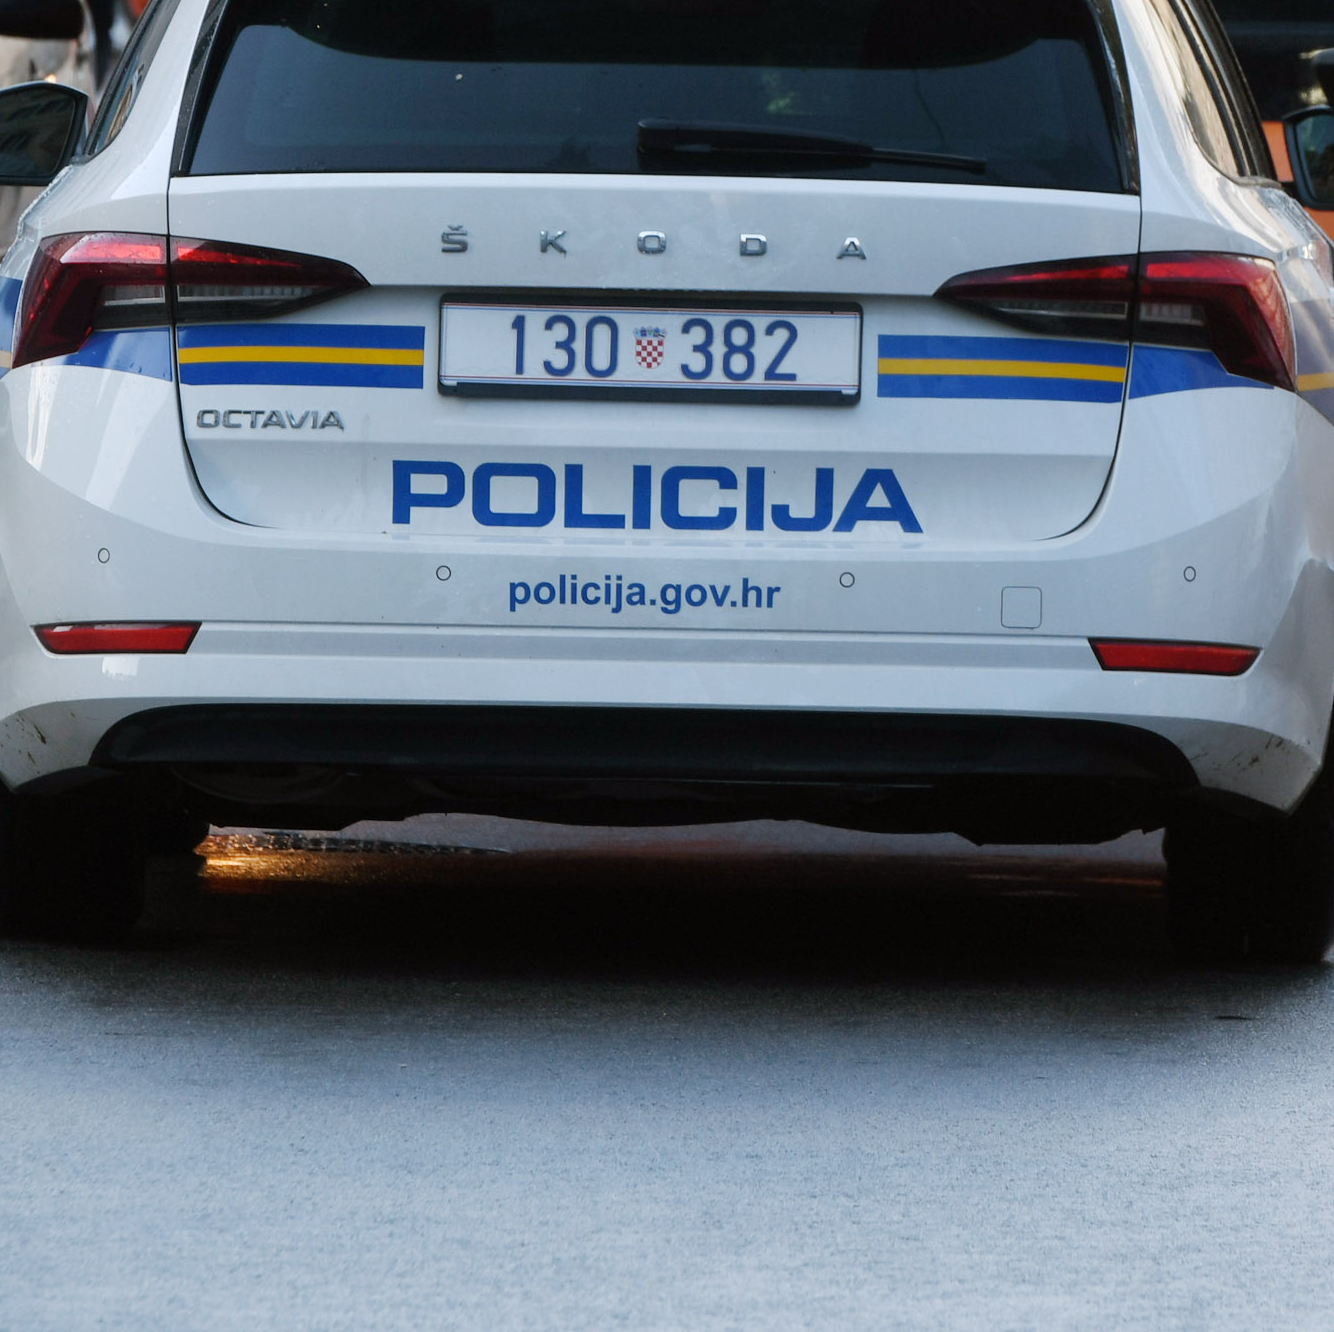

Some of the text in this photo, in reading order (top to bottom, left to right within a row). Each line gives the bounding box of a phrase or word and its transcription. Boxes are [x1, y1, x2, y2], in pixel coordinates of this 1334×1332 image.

[440, 224, 867, 261] ŠKODA
[510, 313, 799, 382] 130 382
[196, 409, 345, 431] OCTAVIA
[392, 459, 925, 536] POLICIJA
[507, 573, 783, 616] policija.gov.hr
